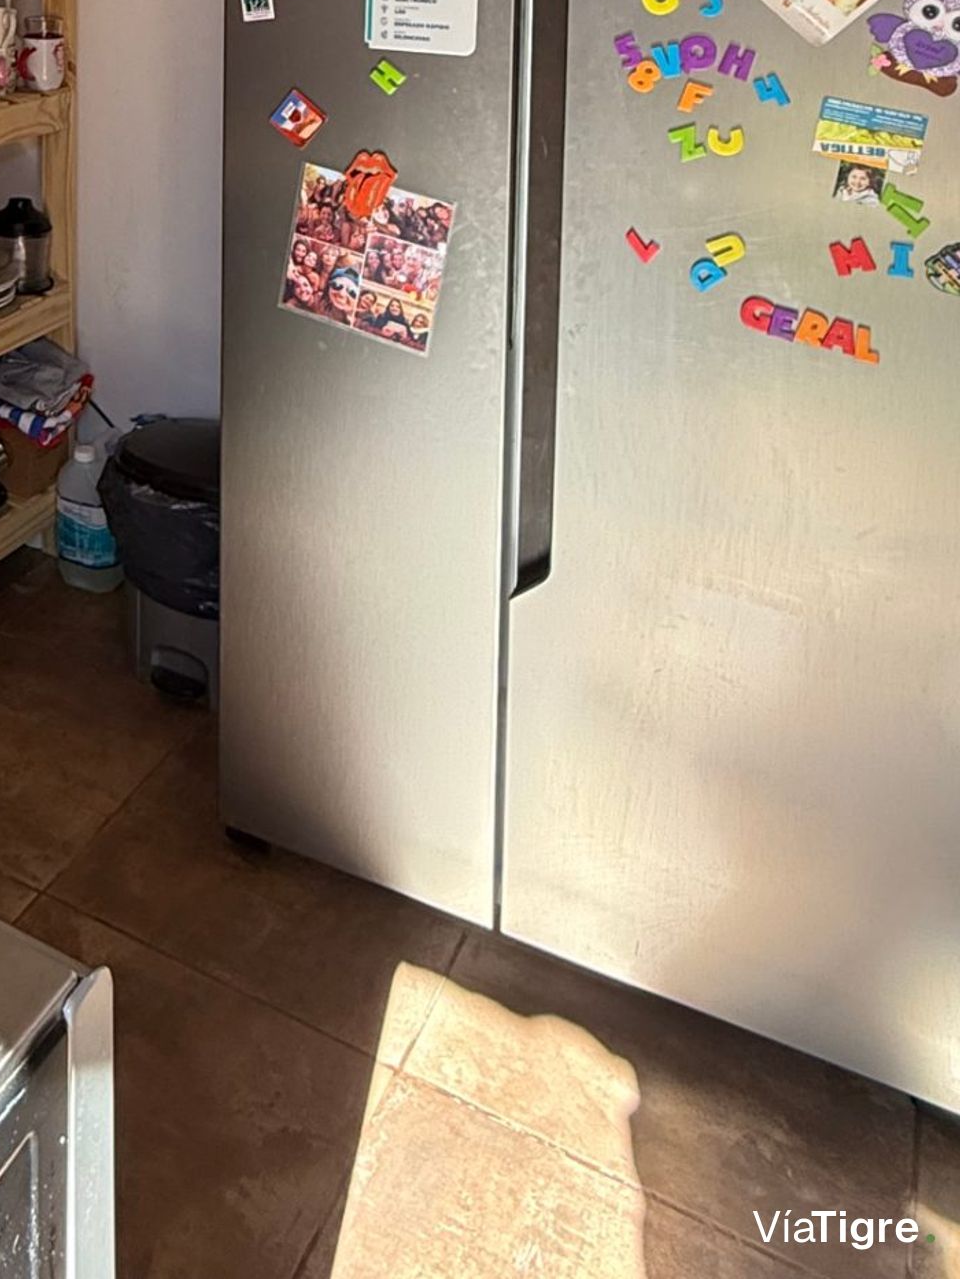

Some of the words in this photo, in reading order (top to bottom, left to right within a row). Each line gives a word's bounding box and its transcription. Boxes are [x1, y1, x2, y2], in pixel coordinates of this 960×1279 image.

[718, 42, 756, 81] H
[677, 79, 714, 112] F
[740, 296, 880, 364] GERAL
